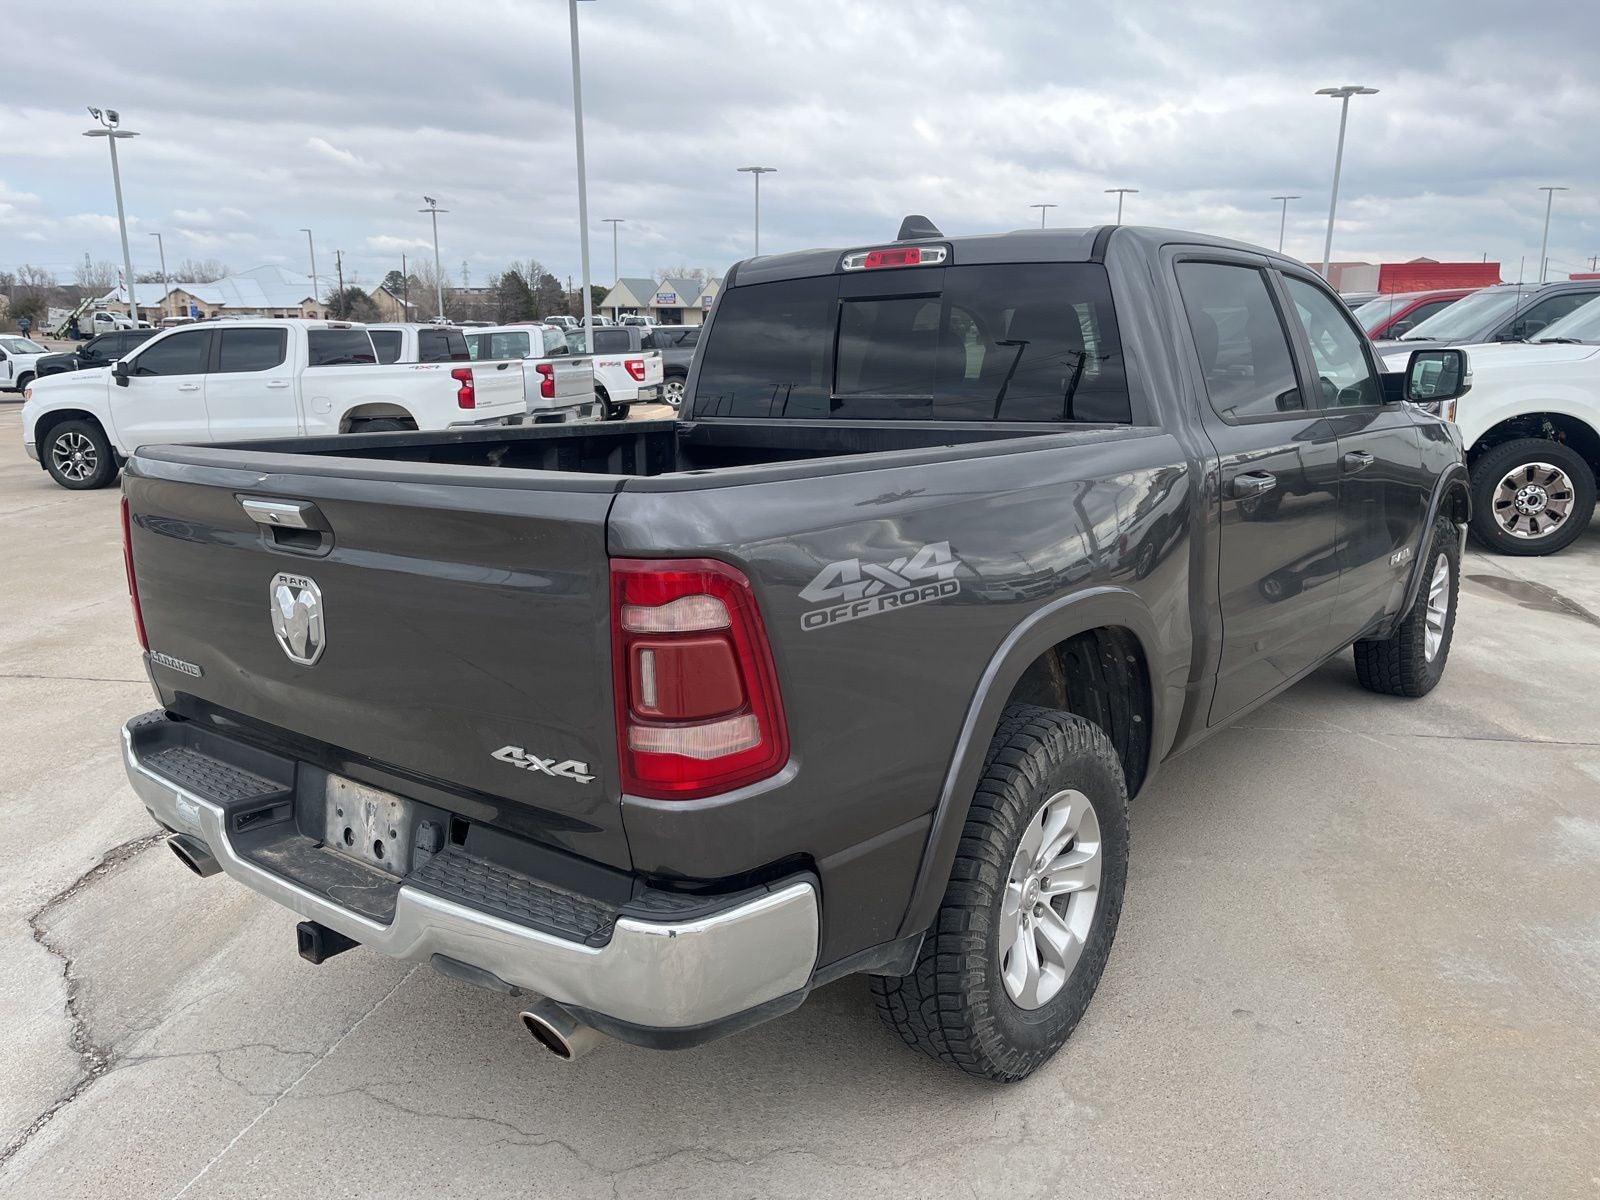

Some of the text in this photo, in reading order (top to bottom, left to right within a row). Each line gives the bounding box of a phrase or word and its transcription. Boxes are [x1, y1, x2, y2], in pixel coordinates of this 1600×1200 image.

[279, 575, 308, 587] RAM
[803, 580, 959, 630] OFF ROAD
